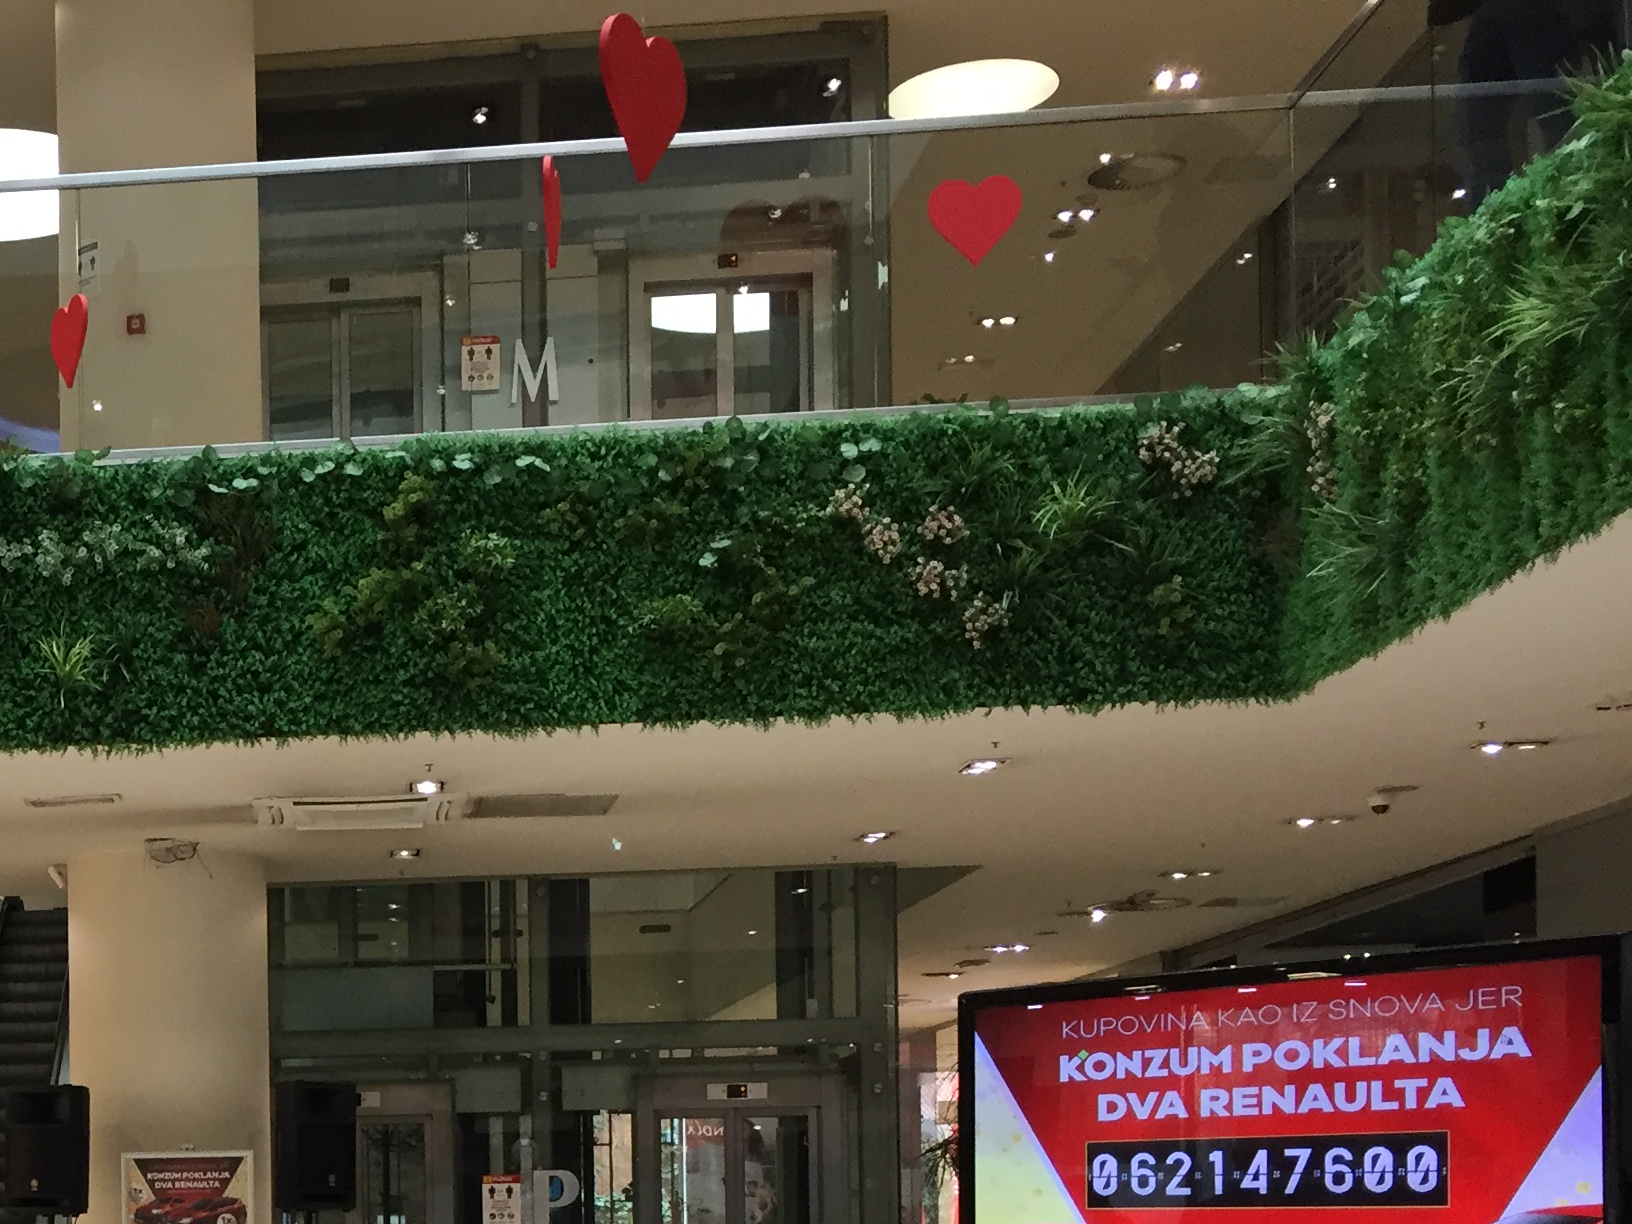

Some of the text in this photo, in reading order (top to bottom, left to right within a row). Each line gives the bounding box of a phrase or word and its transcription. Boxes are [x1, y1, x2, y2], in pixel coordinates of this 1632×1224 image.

[510, 336, 560, 404] M
[1061, 985, 1525, 1039] KUPOVINA KAO IZ SNOVA JER
[1059, 1025, 1534, 1083] KONZUM POKLANJA
[1097, 1076, 1466, 1122] DVA RENAULTA
[146, 1172, 182, 1180] KONZUM
[154, 1180, 221, 1189] DVA RENAULTA
